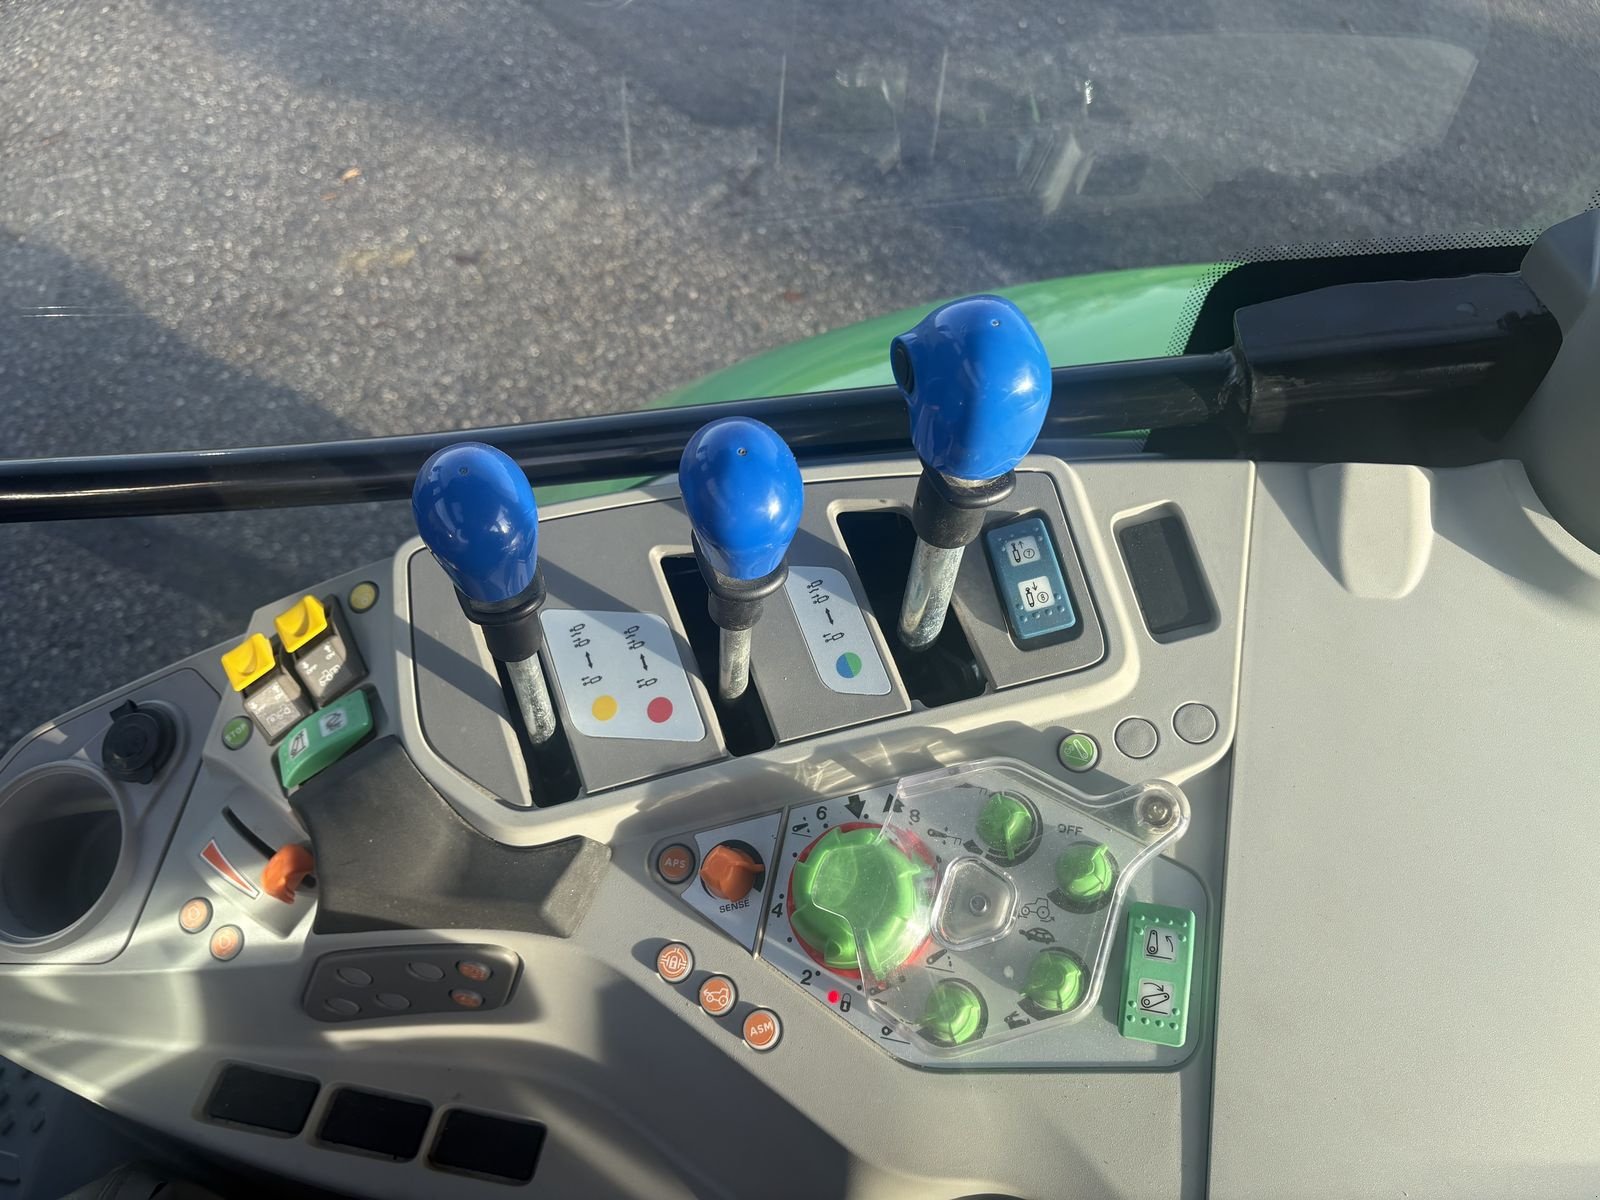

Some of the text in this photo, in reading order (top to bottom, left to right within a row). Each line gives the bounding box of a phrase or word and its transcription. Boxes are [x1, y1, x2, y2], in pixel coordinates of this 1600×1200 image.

[224, 722, 247, 742] STOP
[816, 806, 827, 820] 6
[1058, 823, 1084, 836] OFF
[664, 857, 686, 869] APS
[719, 899, 750, 914] SENSE
[771, 904, 783, 918] 4
[800, 969, 812, 985] 2
[749, 1022, 774, 1037] ASM
